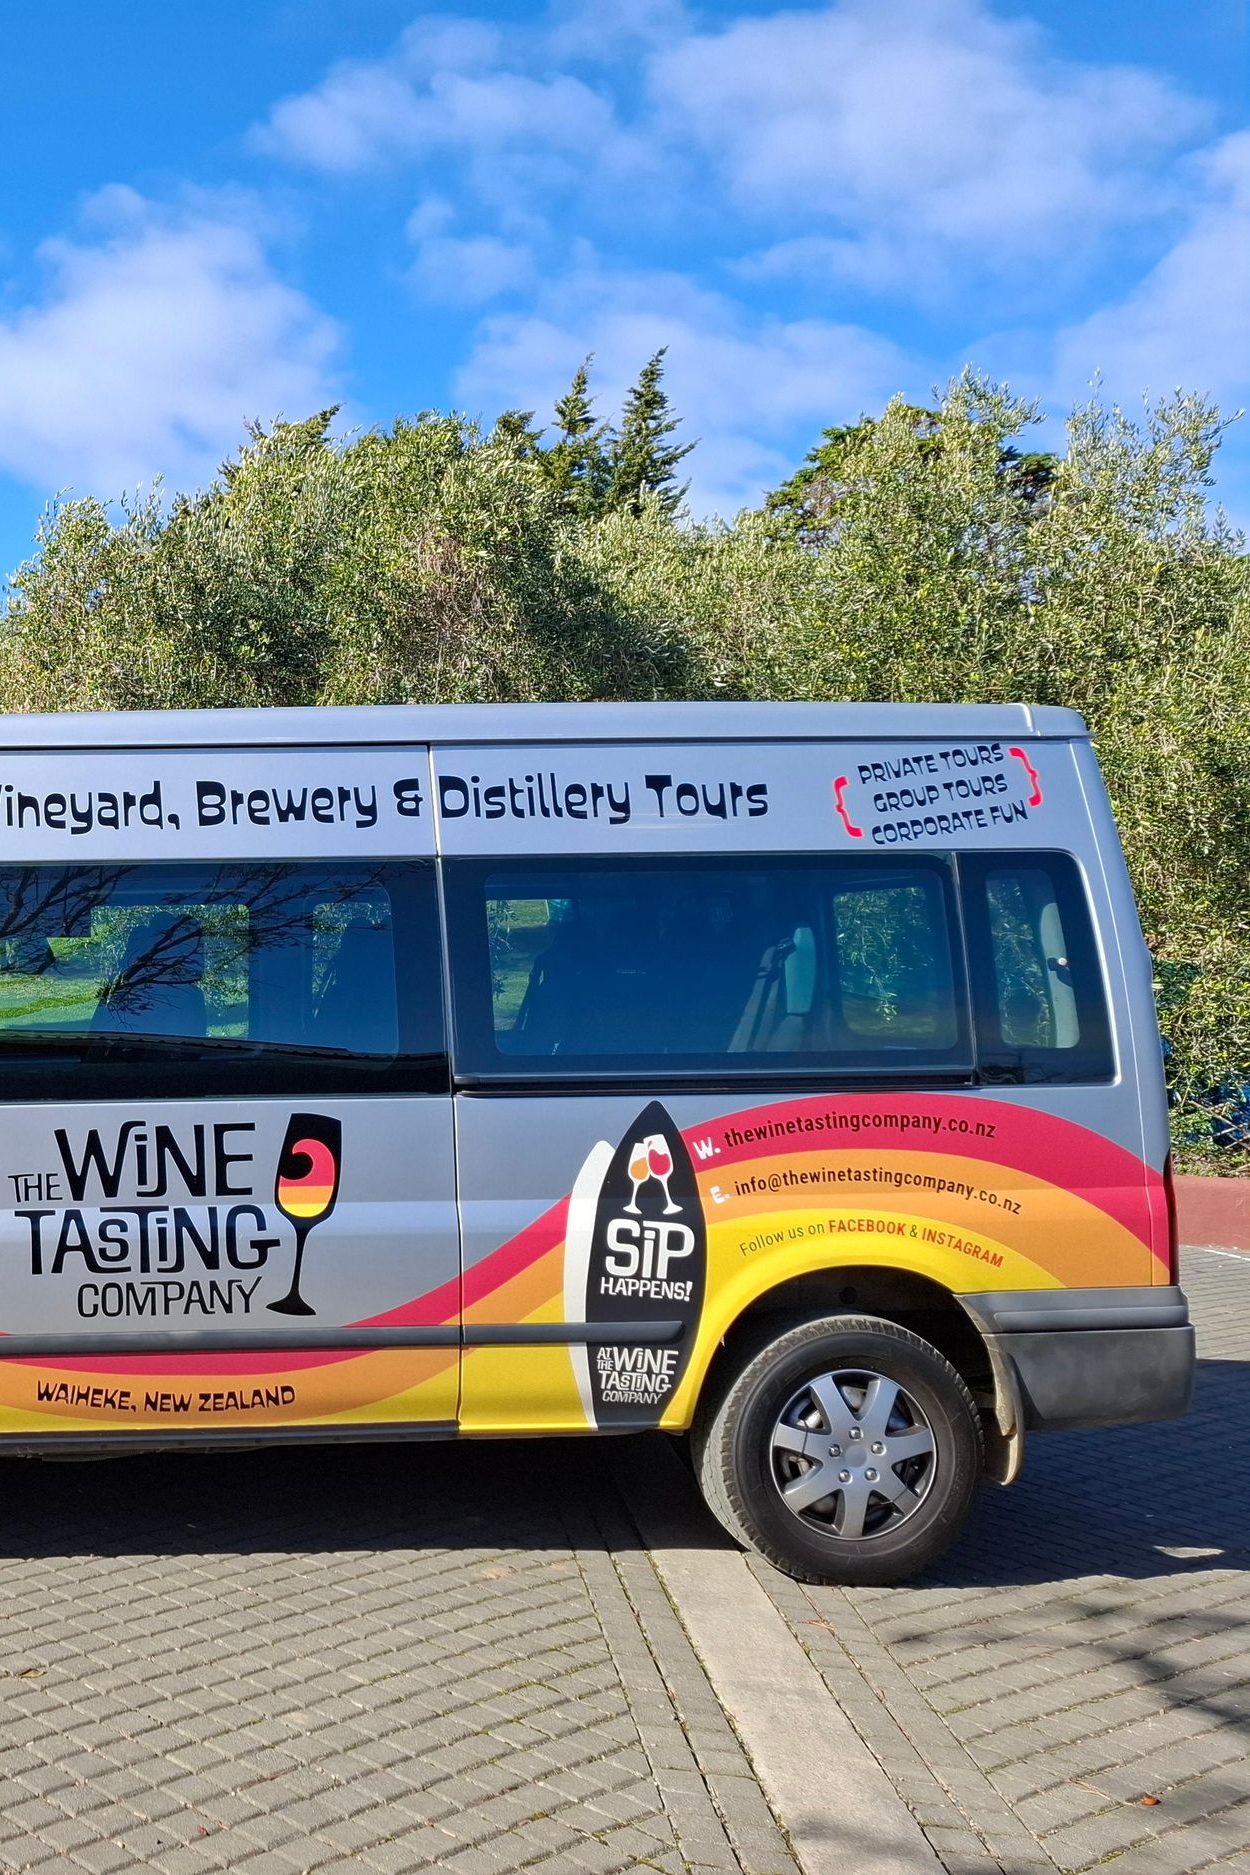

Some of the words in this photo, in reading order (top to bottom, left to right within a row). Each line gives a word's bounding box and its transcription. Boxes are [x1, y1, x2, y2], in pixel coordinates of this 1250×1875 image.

[857, 754, 939, 784] PRIVATE
[939, 742, 1005, 770] TOURS
[195, 779, 379, 829] Brewery
[392, 777, 424, 817] &
[438, 772, 631, 825] Distillery
[644, 774, 769, 820] Tours
[873, 785, 940, 812] GROUP
[942, 773, 1008, 801] TOURS
[871, 808, 988, 845] CORPORATE
[989, 799, 1029, 825] FUN
[692, 1136, 721, 1160] W.
[723, 1110, 998, 1148] thewinetastingcompany.co.nz
[7, 1172, 63, 1203] THE
[709, 1185, 731, 1205] E.
[734, 1167, 1023, 1215] info@thewinetastingcompany.co.nz
[739, 1231, 785, 1257] Follow
[788, 1225, 805, 1240] us
[808, 1222, 826, 1235] on
[828, 1218, 907, 1237] FACEBOOK
[909, 1225, 919, 1238] &
[921, 1227, 1005, 1269] INSTAGRAM
[77, 1276, 263, 1318] COMPANY
[600, 1276, 694, 1302] HAPPENS!
[596, 1347, 613, 1360] AT
[596, 1359, 614, 1371] THE
[37, 1380, 137, 1412] WAIHEKE,
[144, 1390, 193, 1412] NEW
[198, 1385, 296, 1411] ZEALAND
[602, 1390, 662, 1404] COMPANY
